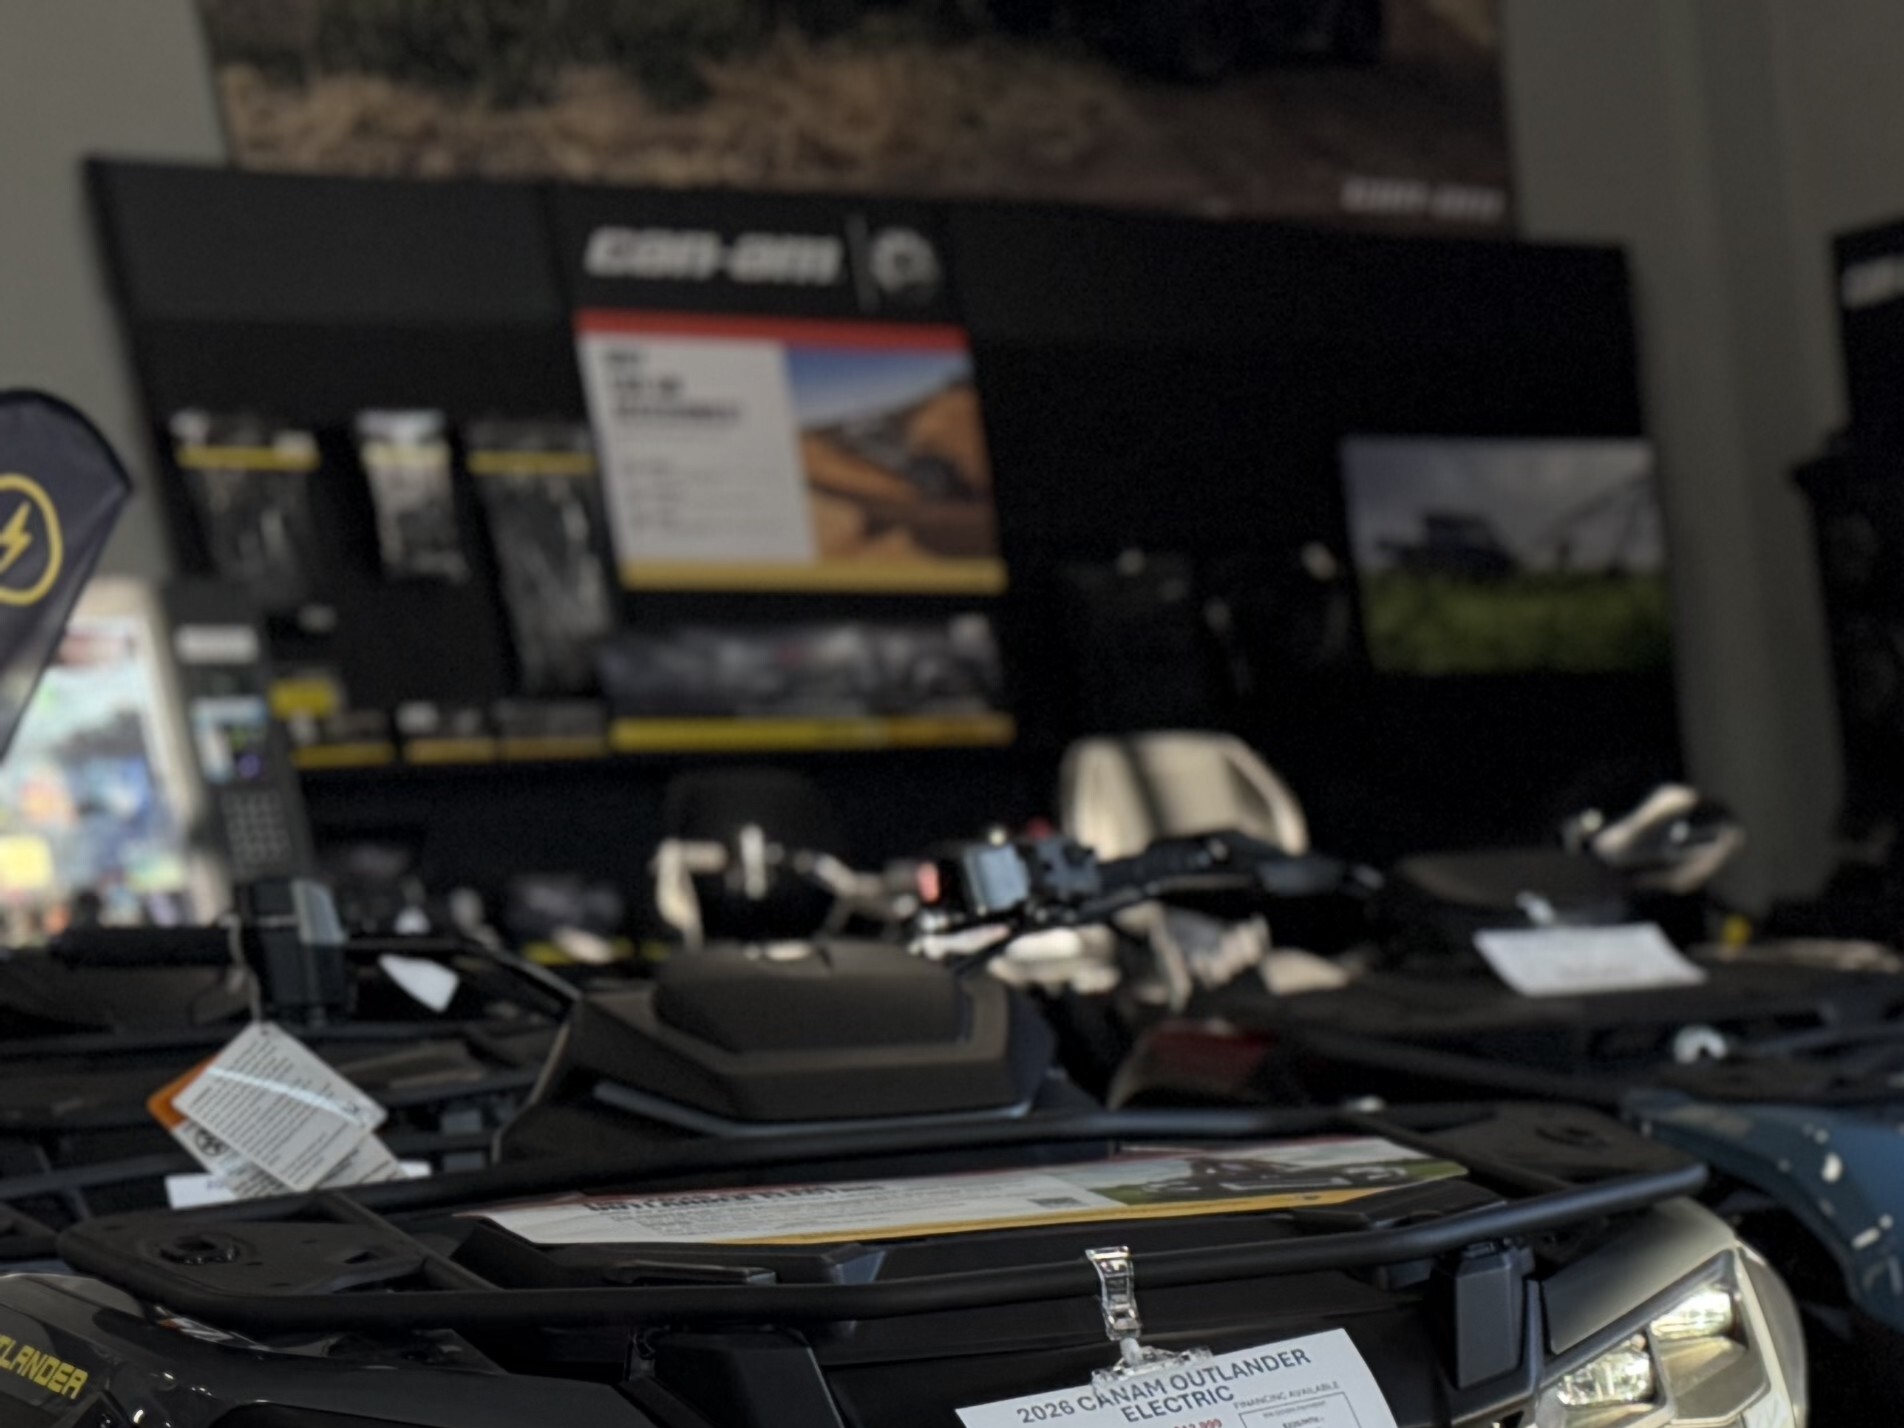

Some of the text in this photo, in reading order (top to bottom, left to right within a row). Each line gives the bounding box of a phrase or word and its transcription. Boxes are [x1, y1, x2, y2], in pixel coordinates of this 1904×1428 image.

[1017, 1349, 1312, 1424] 2026 CANAM OUTLANDER
[1121, 1384, 1235, 1423] ELECTRIC
